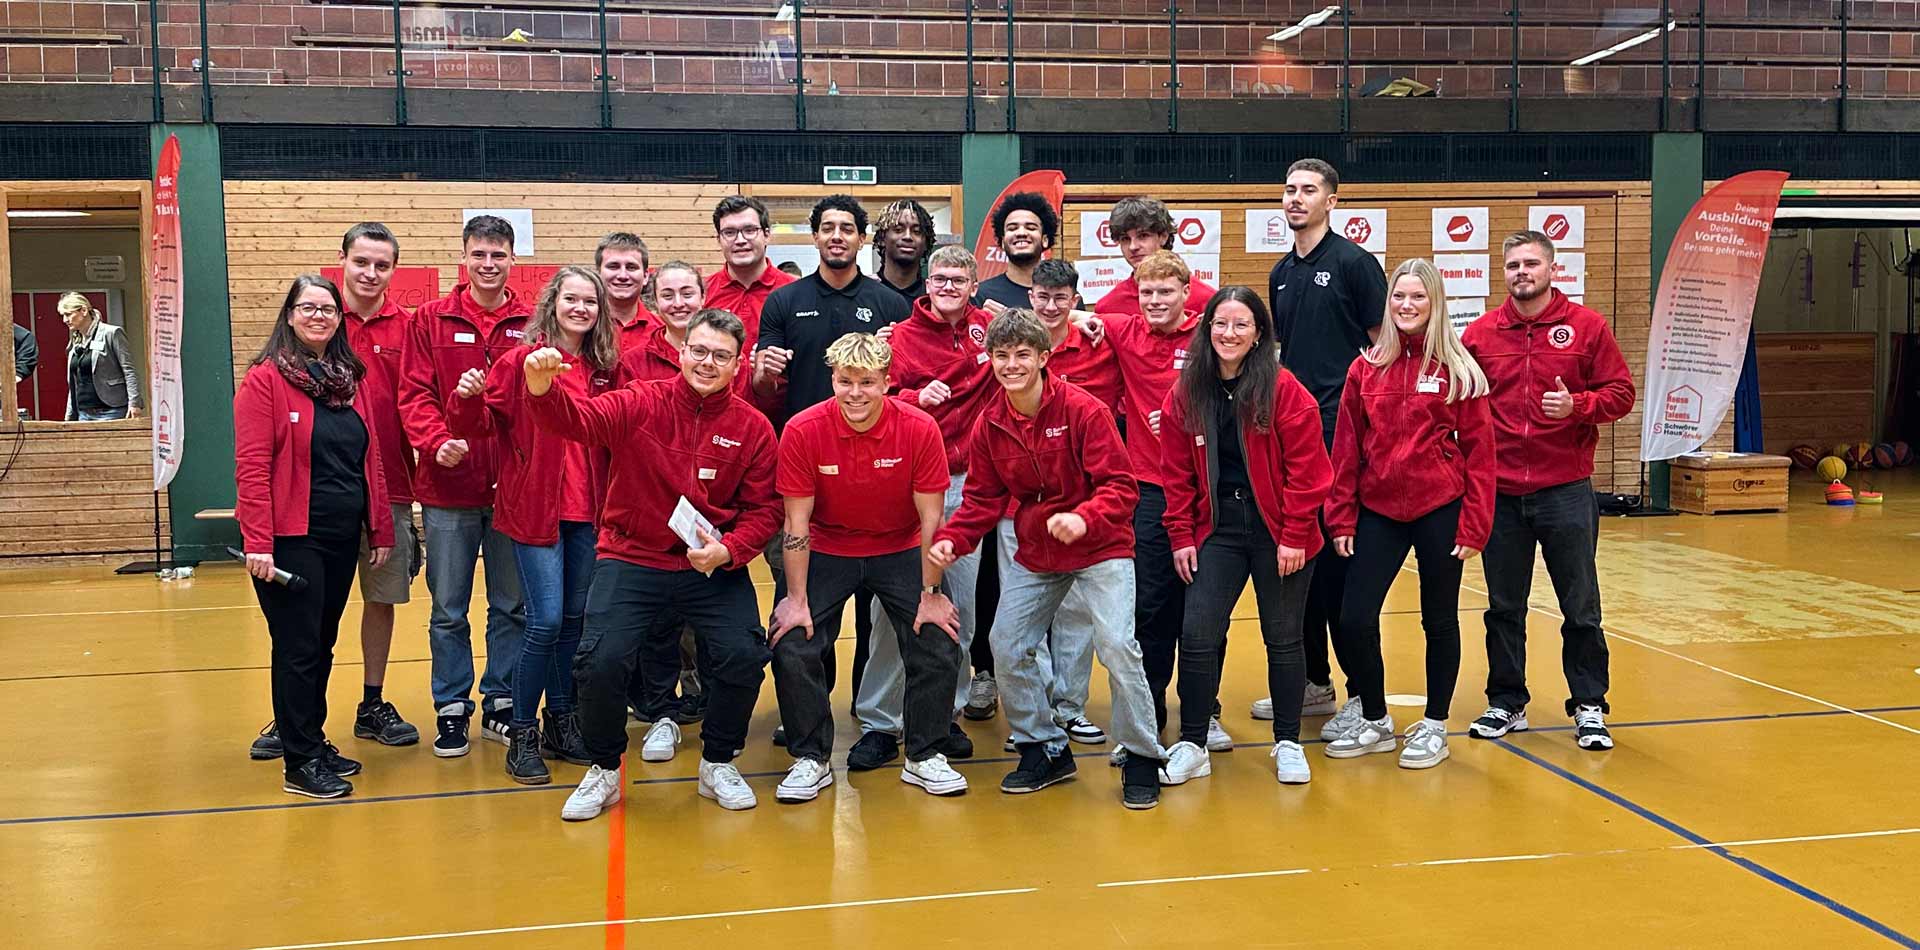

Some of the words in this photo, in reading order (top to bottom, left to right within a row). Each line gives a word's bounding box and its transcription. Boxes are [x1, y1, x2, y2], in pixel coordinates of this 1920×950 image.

[1734, 203, 1760, 214] Deine
[1698, 210, 1771, 232] Ausbildung.
[1710, 223, 1734, 233] Deine
[1694, 231, 1748, 246] Vorteile.
[984, 246, 1009, 263] Zu
[1715, 246, 1735, 257] geht
[1095, 268, 1115, 276] Team
[1440, 268, 1463, 279] Team
[1465, 268, 1483, 278] Holz
